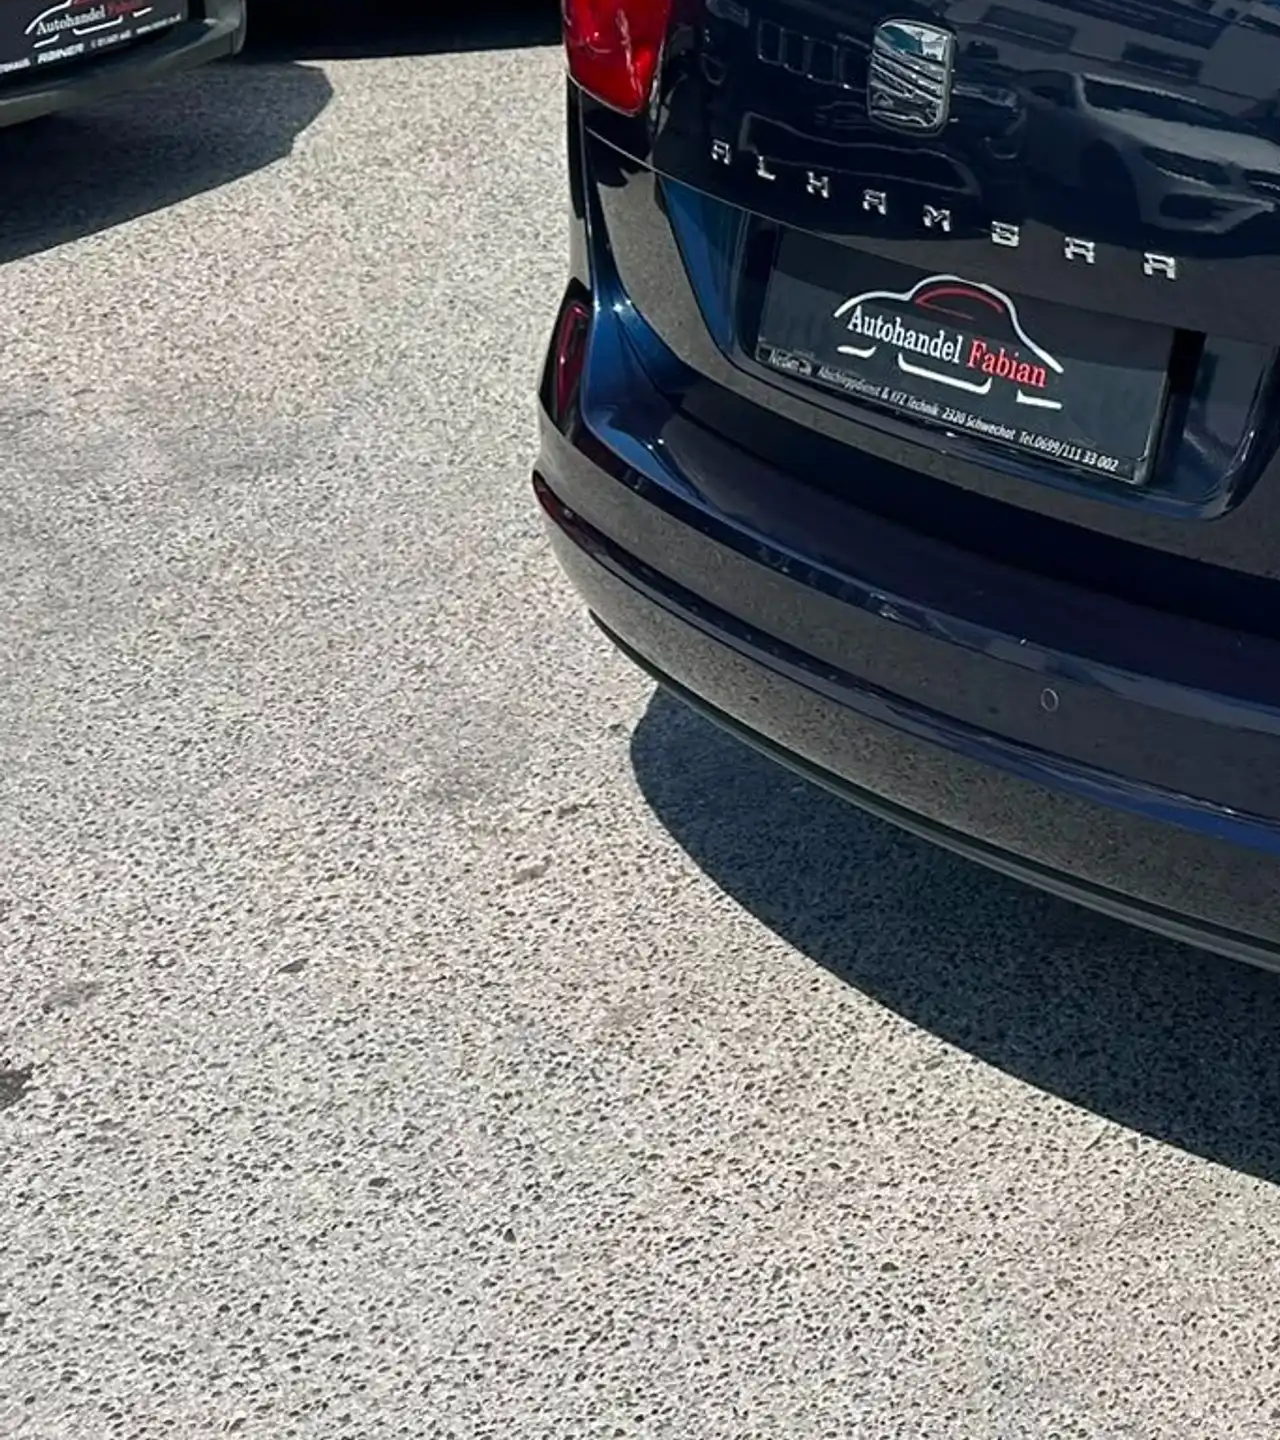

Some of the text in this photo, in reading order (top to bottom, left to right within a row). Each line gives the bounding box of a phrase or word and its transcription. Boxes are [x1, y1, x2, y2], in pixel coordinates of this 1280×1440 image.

[710, 139, 1177, 280] ALHAMBRA
[847, 304, 964, 364] Autohandel
[966, 336, 1048, 389] Fabian
